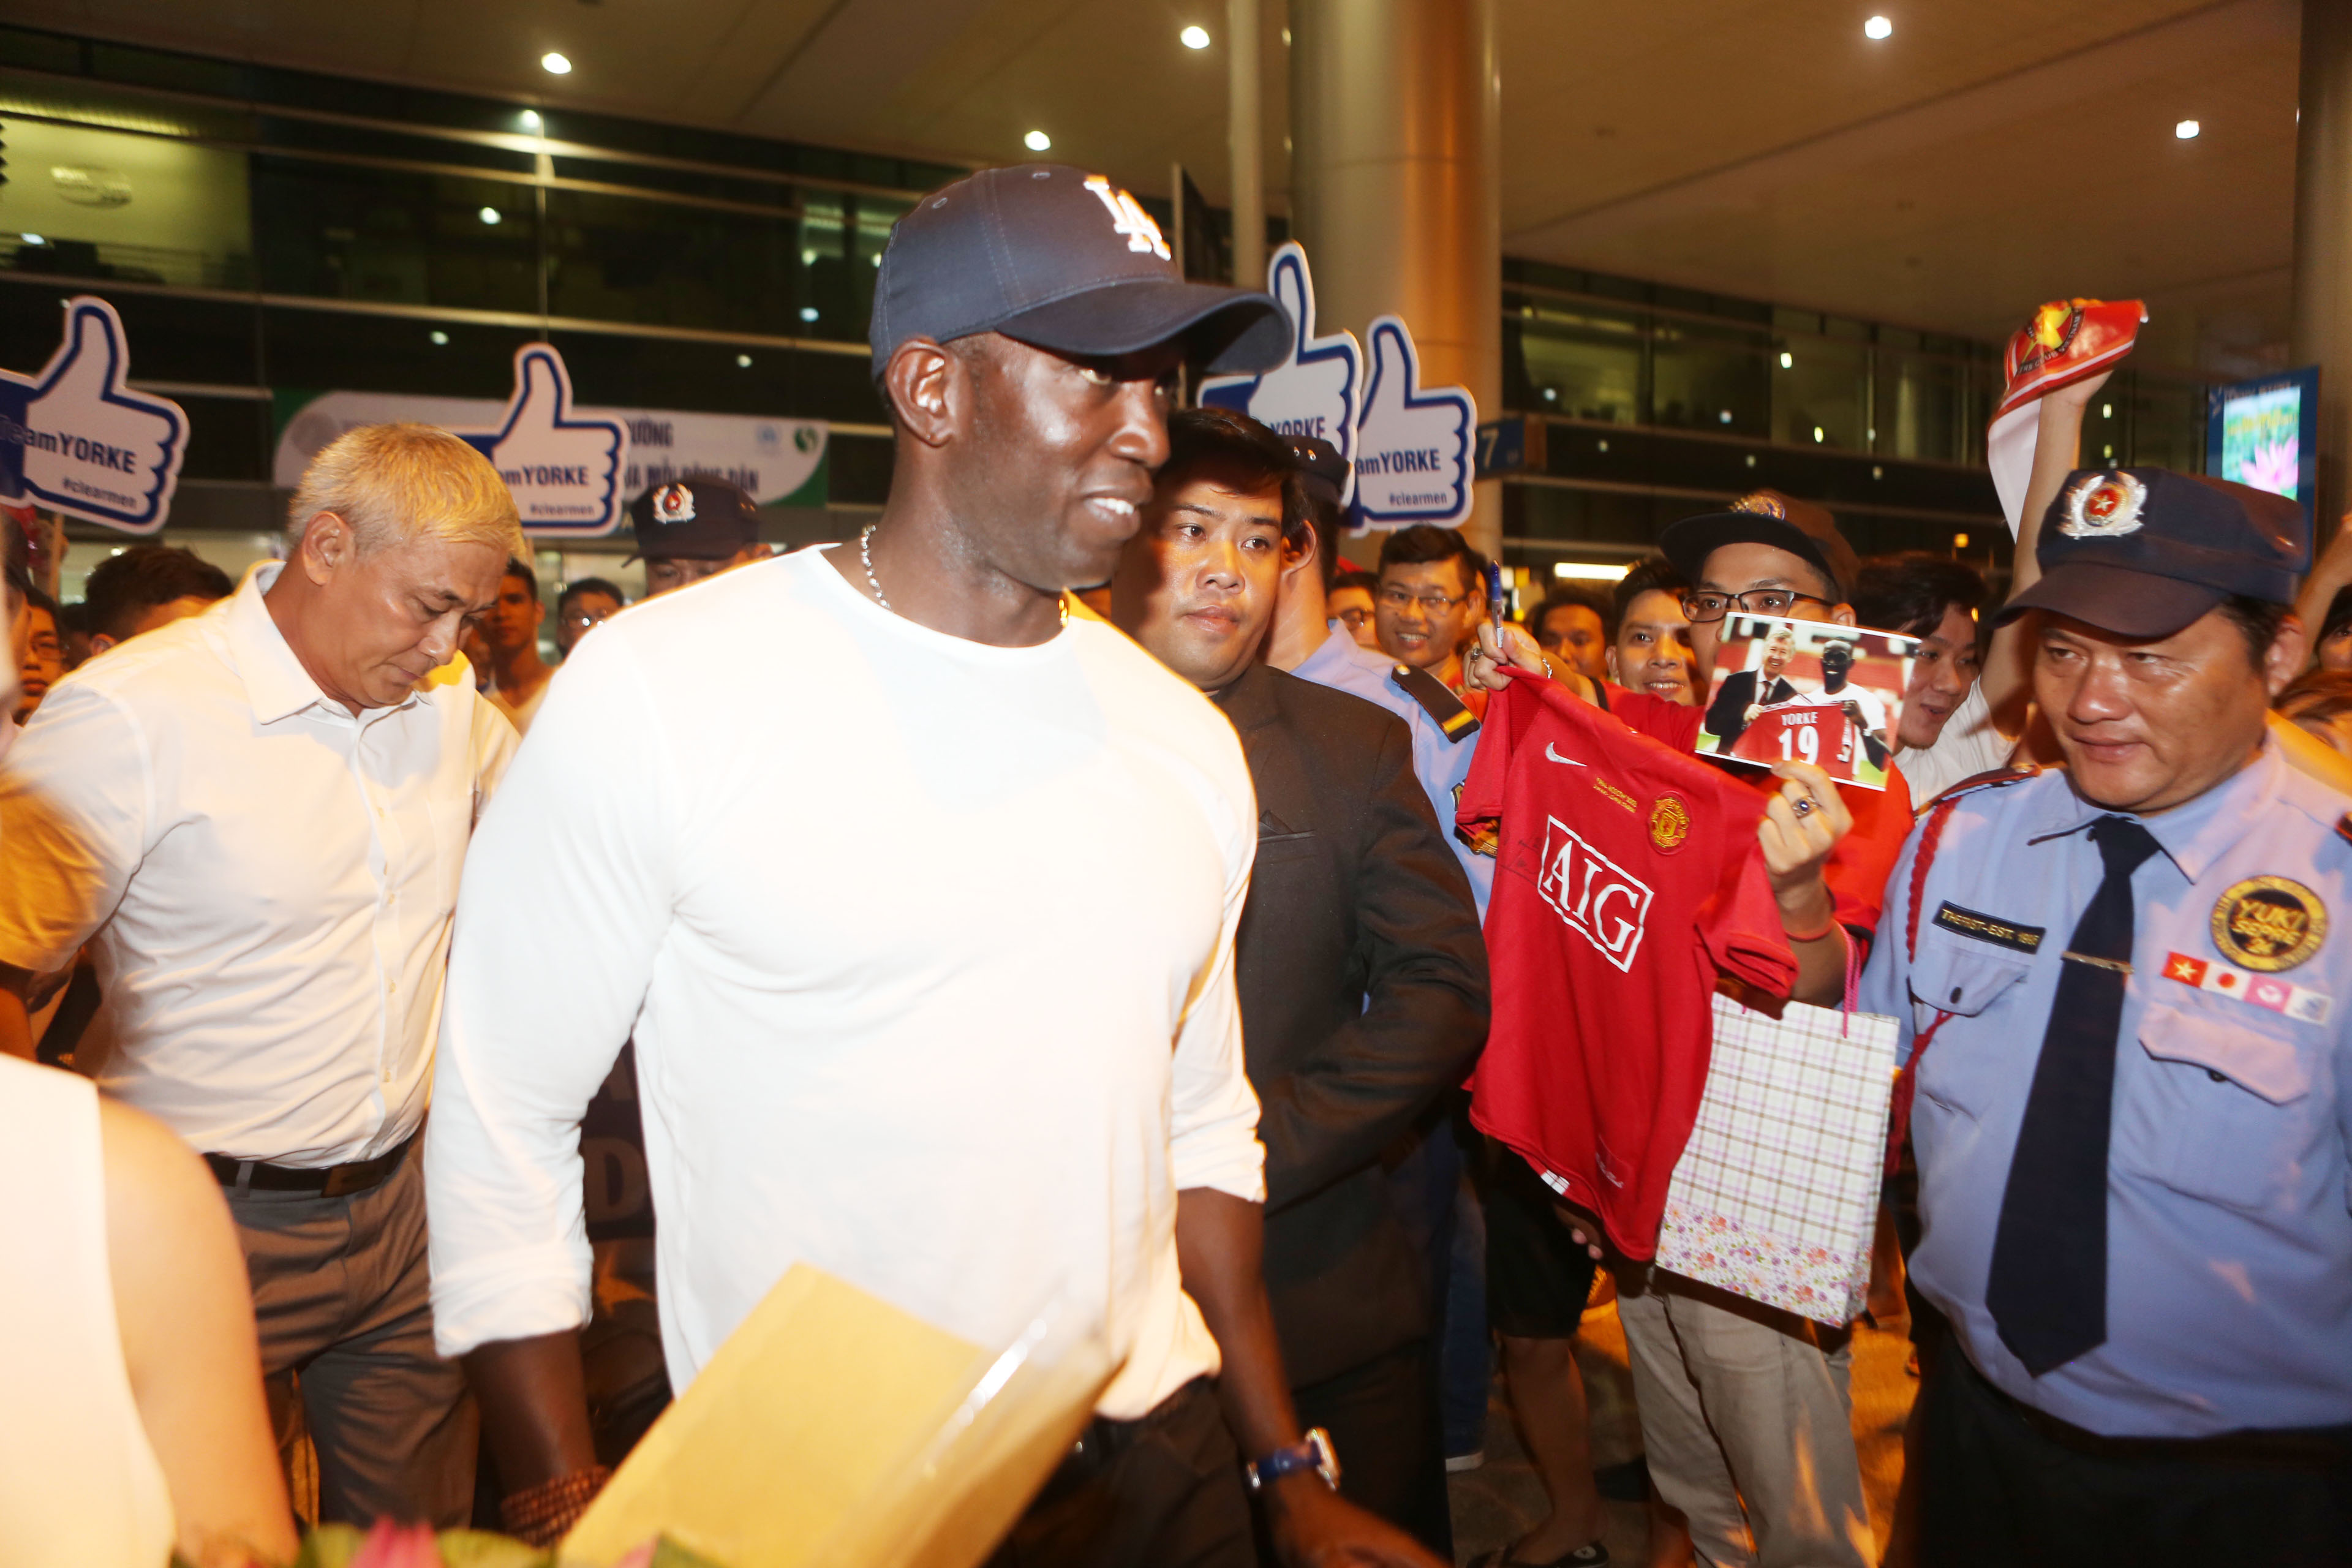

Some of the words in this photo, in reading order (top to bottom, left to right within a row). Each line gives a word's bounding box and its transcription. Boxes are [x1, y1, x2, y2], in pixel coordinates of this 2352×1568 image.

[1481, 429, 1499, 469] 7
[1389, 491, 1447, 506] #clearmen
[1781, 711, 1819, 727] YORKE
[1778, 725, 1819, 766] 19
[1542, 840, 1640, 953] AIG
